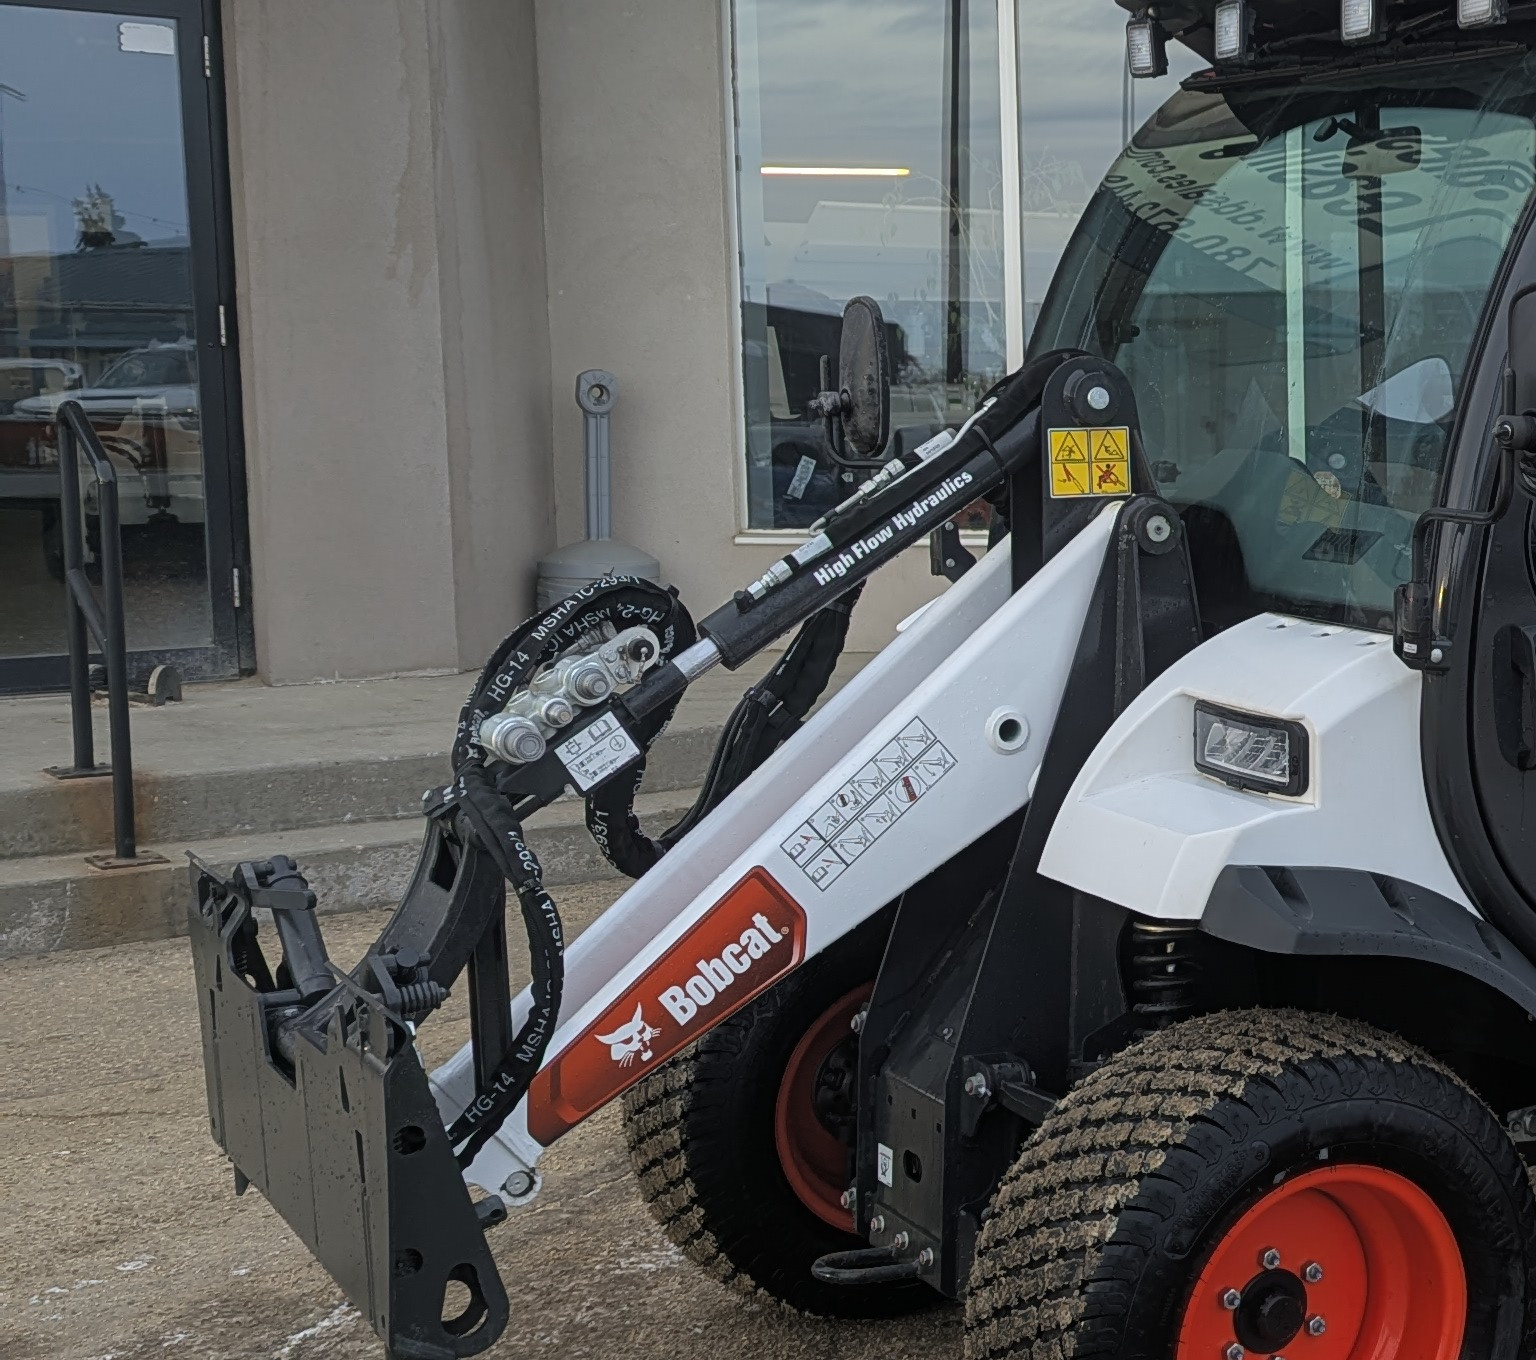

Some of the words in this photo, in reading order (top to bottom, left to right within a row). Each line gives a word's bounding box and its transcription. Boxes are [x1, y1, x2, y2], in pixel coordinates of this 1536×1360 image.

[812, 553, 856, 587] High
[850, 525, 895, 560] Flow
[890, 470, 973, 532] Hydraulics
[486, 650, 531, 703] HG-14
[530, 597, 578, 641] MSHA
[561, 607, 612, 637] MSHA
[657, 912, 784, 1027] Bobcat
[464, 1071, 516, 1124] HG-14
